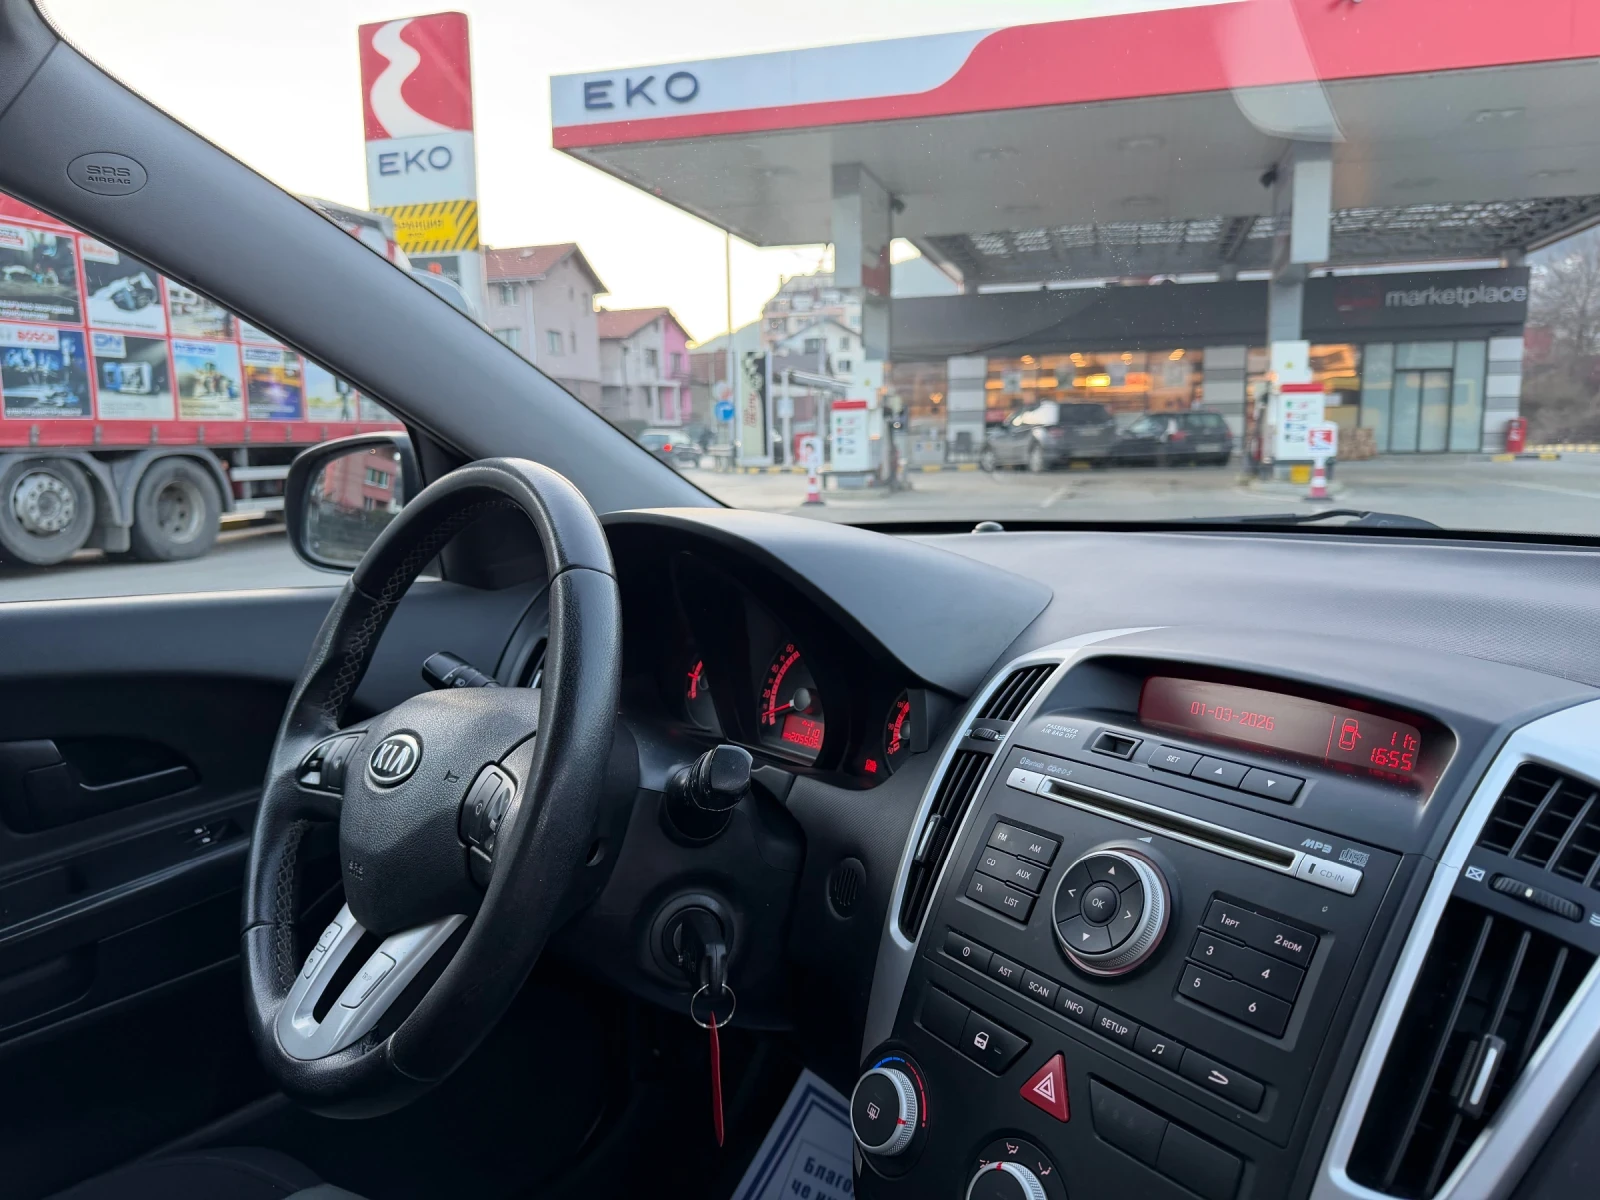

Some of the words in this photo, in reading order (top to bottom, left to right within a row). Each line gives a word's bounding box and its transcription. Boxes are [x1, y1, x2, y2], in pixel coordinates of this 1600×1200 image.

[583, 71, 699, 109] EKO
[378, 145, 452, 176] EKO
[86, 164, 131, 177] SRS
[87, 176, 131, 185] AIRBAG
[1385, 283, 1527, 309] marketplace
[1190, 700, 1275, 732] 01-03-2026
[1046, 723, 1079, 734] PASSENGER
[1064, 732, 1077, 740] OFF
[372, 743, 411, 774] KIA
[1166, 754, 1181, 763] SET
[1370, 747, 1413, 771] 16:55
[997, 832, 1008, 842] FM
[1029, 843, 1042, 854] AM
[1300, 838, 1333, 854] MP3
[986, 858, 996, 867] CD
[1015, 868, 1032, 881] AUX
[976, 883, 984, 893] TA
[1004, 896, 1019, 908] LIST
[1092, 898, 1105, 909] OK
[1206, 946, 1214, 955] 3
[998, 965, 1012, 978] AST
[1261, 969, 1270, 979] 4
[1028, 981, 1050, 997] SCAN
[1193, 978, 1201, 988] 5
[1064, 999, 1084, 1015] INFO
[1248, 1002, 1257, 1012] 6
[1101, 1017, 1128, 1036] SETUP
[803, 1156, 854, 1197] Благо
